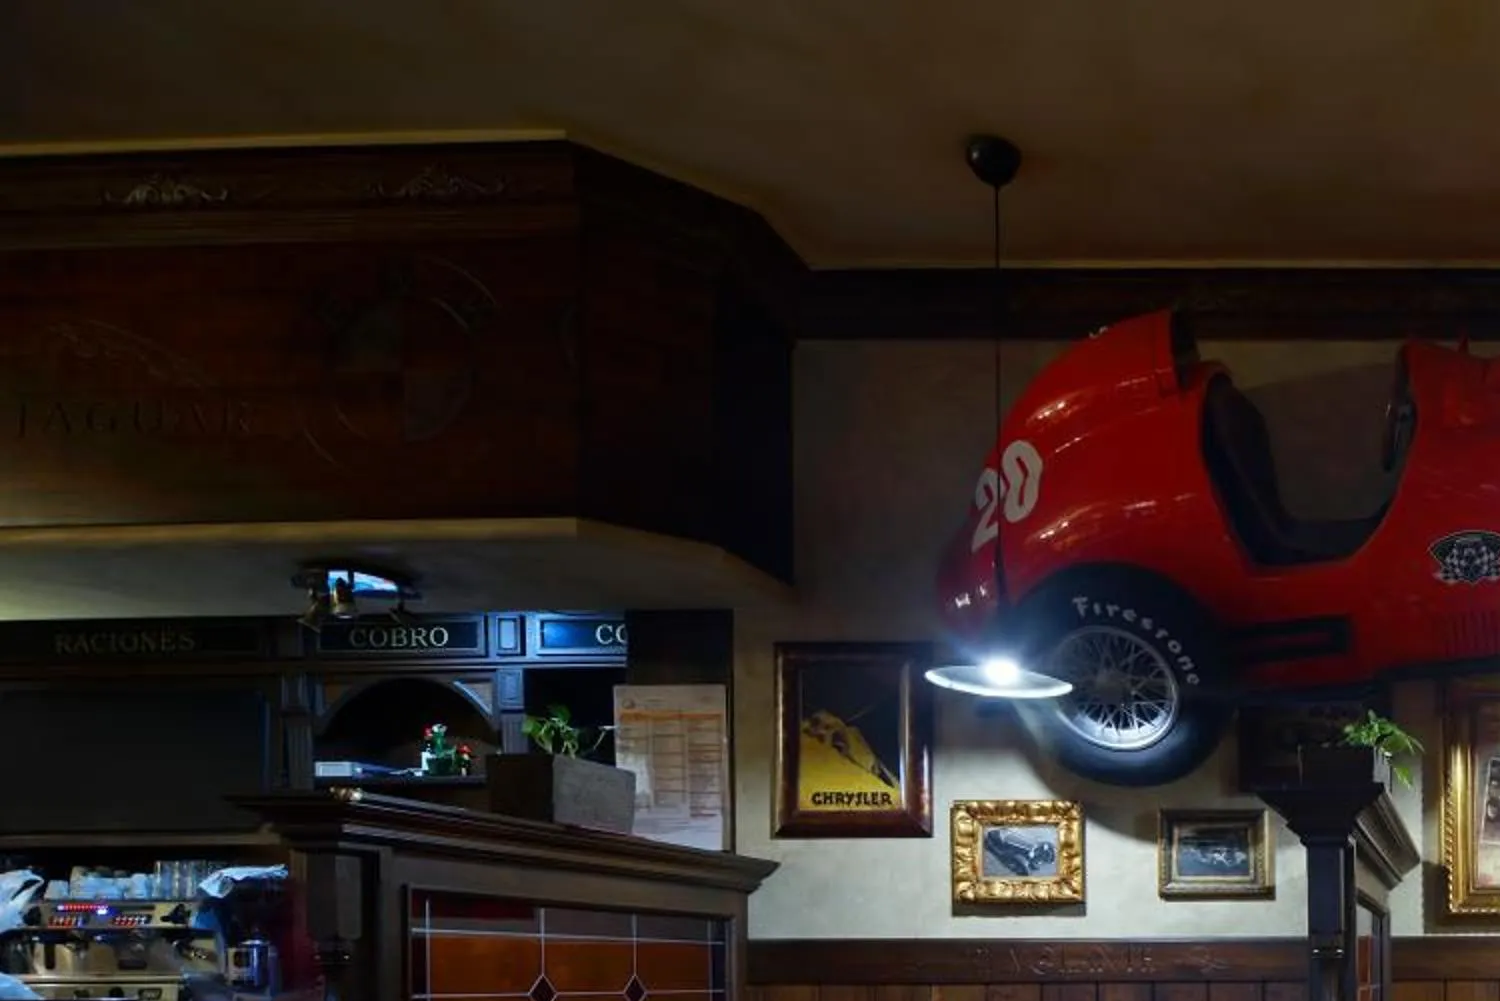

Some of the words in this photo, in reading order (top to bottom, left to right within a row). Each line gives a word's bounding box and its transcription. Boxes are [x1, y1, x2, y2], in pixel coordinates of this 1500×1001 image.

[17, 399, 252, 438] JAGUAR
[971, 439, 1044, 554] 20
[53, 628, 198, 656] RACIONES
[349, 624, 450, 648] COBRO
[1071, 596, 1201, 686] Firestone
[811, 790, 893, 807] CHRYSLER
